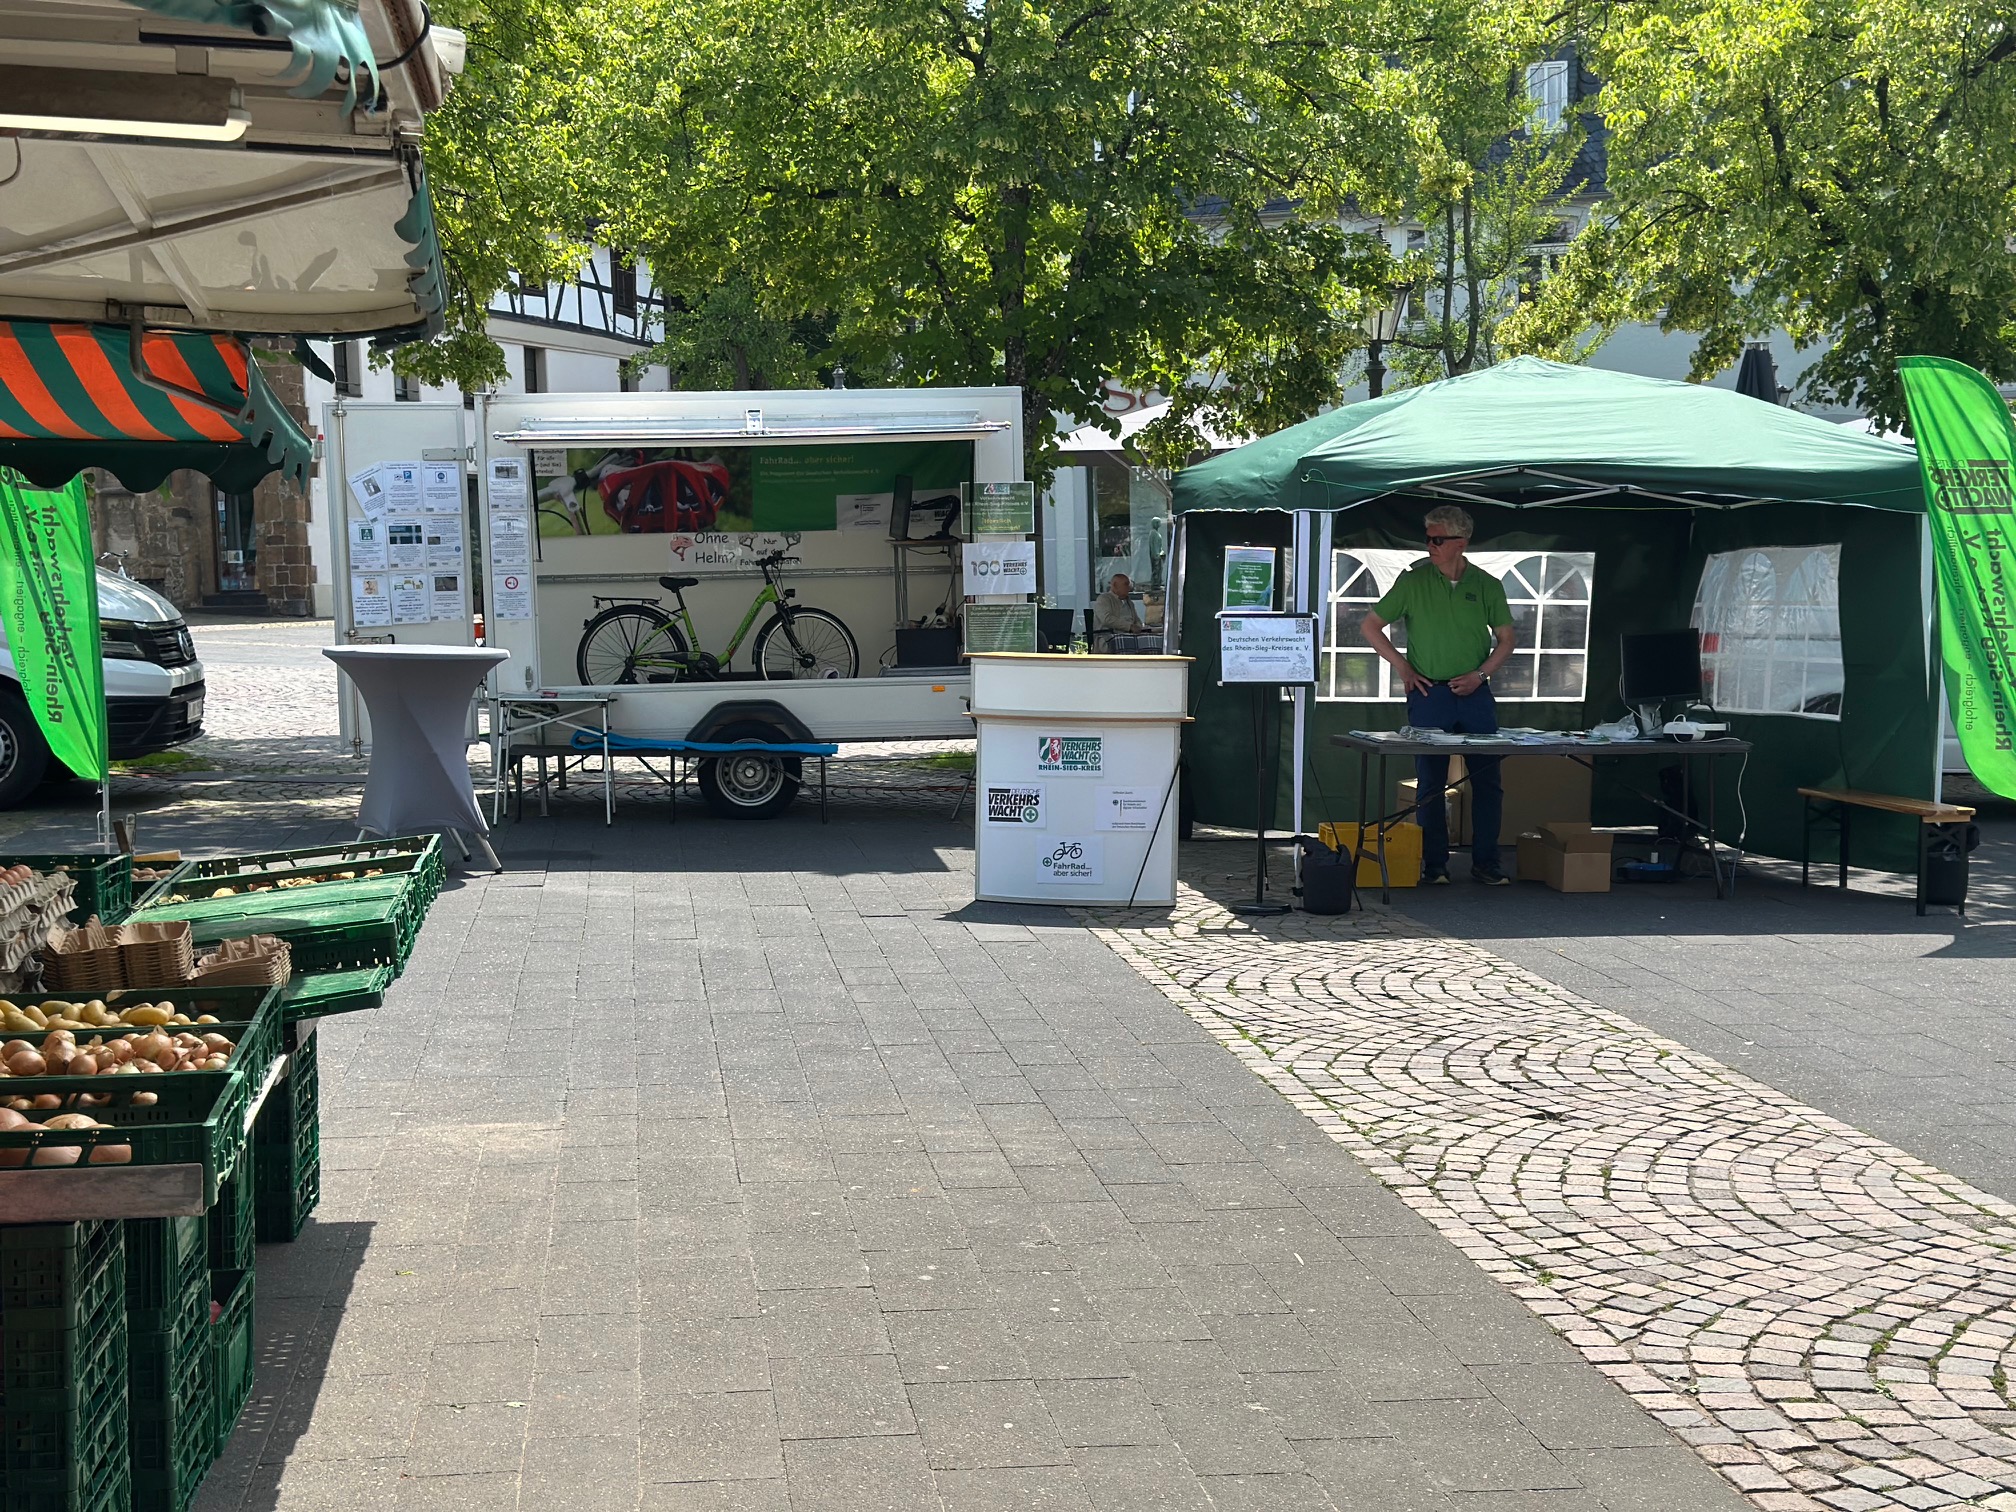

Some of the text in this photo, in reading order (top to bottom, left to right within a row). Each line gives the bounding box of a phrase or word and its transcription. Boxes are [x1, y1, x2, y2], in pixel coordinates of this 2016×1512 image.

[694, 532, 729, 544] Ohne
[695, 551, 736, 564] Helm?
[756, 548, 768, 556] auf
[970, 560, 1000, 576] 100
[1061, 742, 1102, 751] VERKEHRS
[1062, 750, 1090, 760] WACHT
[988, 794, 1040, 806] VERKEHRS
[988, 806, 1024, 817] WACHT
